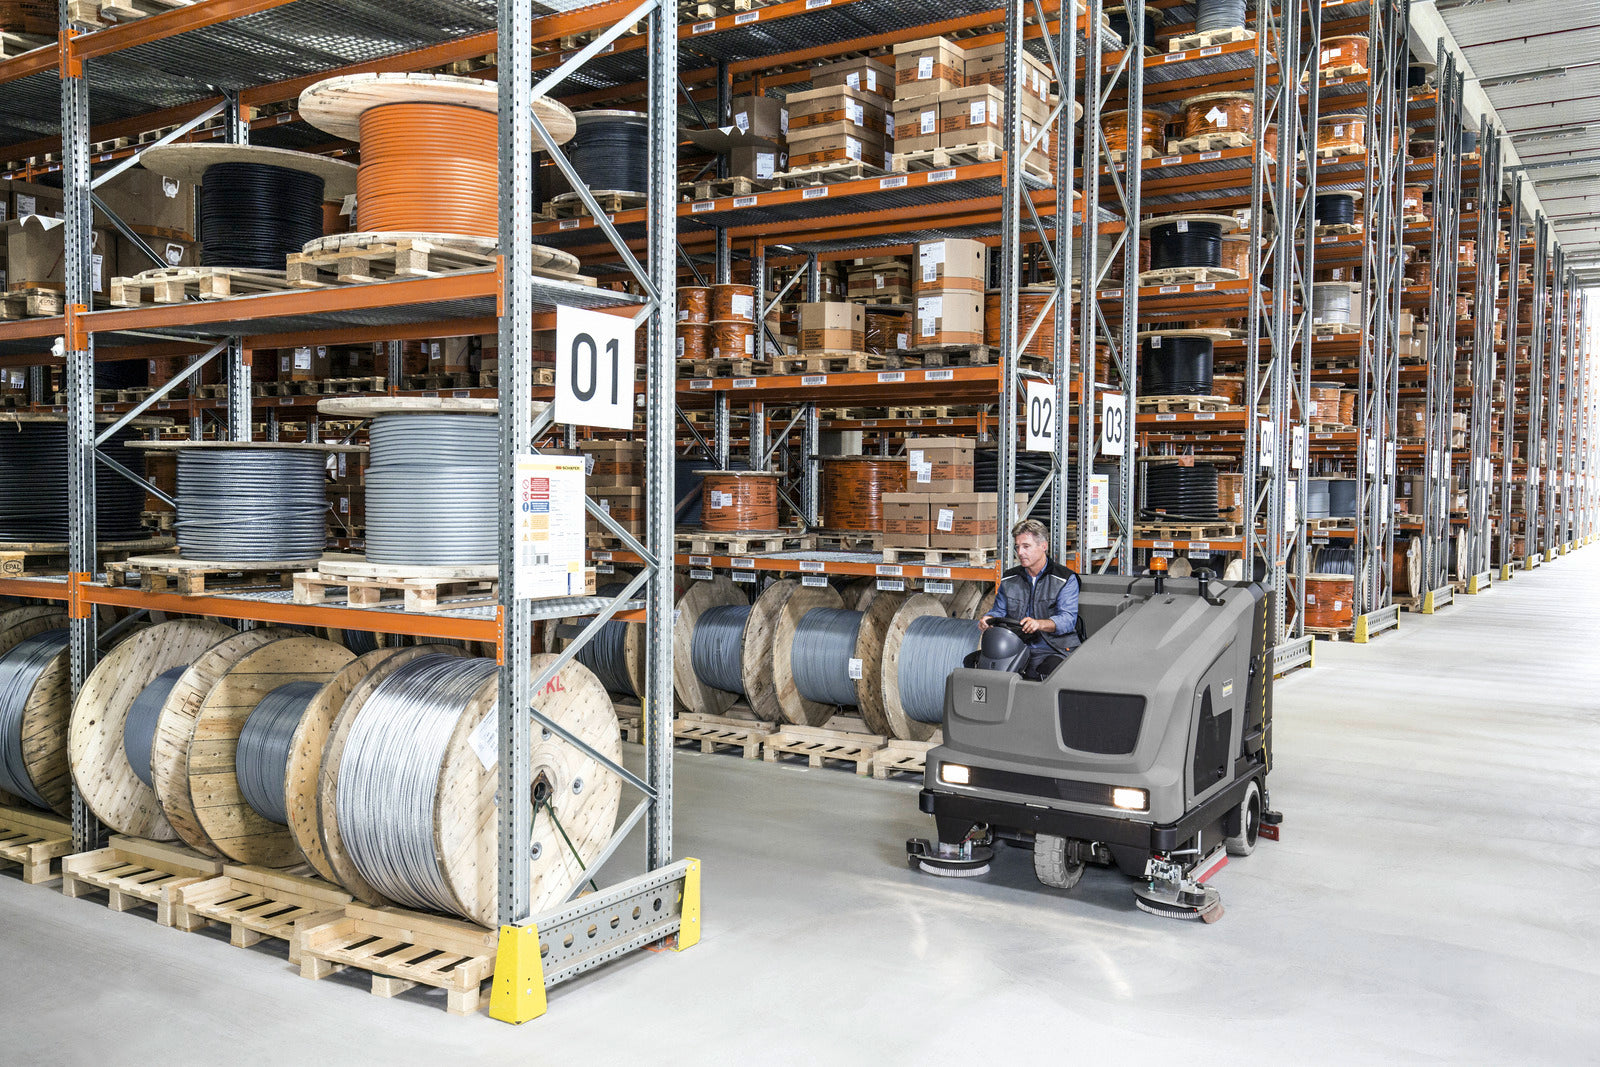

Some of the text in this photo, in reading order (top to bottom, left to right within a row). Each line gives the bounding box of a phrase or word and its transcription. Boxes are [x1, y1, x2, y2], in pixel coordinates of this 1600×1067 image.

[571, 332, 619, 405] 01
[1031, 396, 1052, 438] 02
[1106, 406, 1122, 444] 03
[1262, 430, 1272, 457] 04
[1294, 435, 1302, 460] 05
